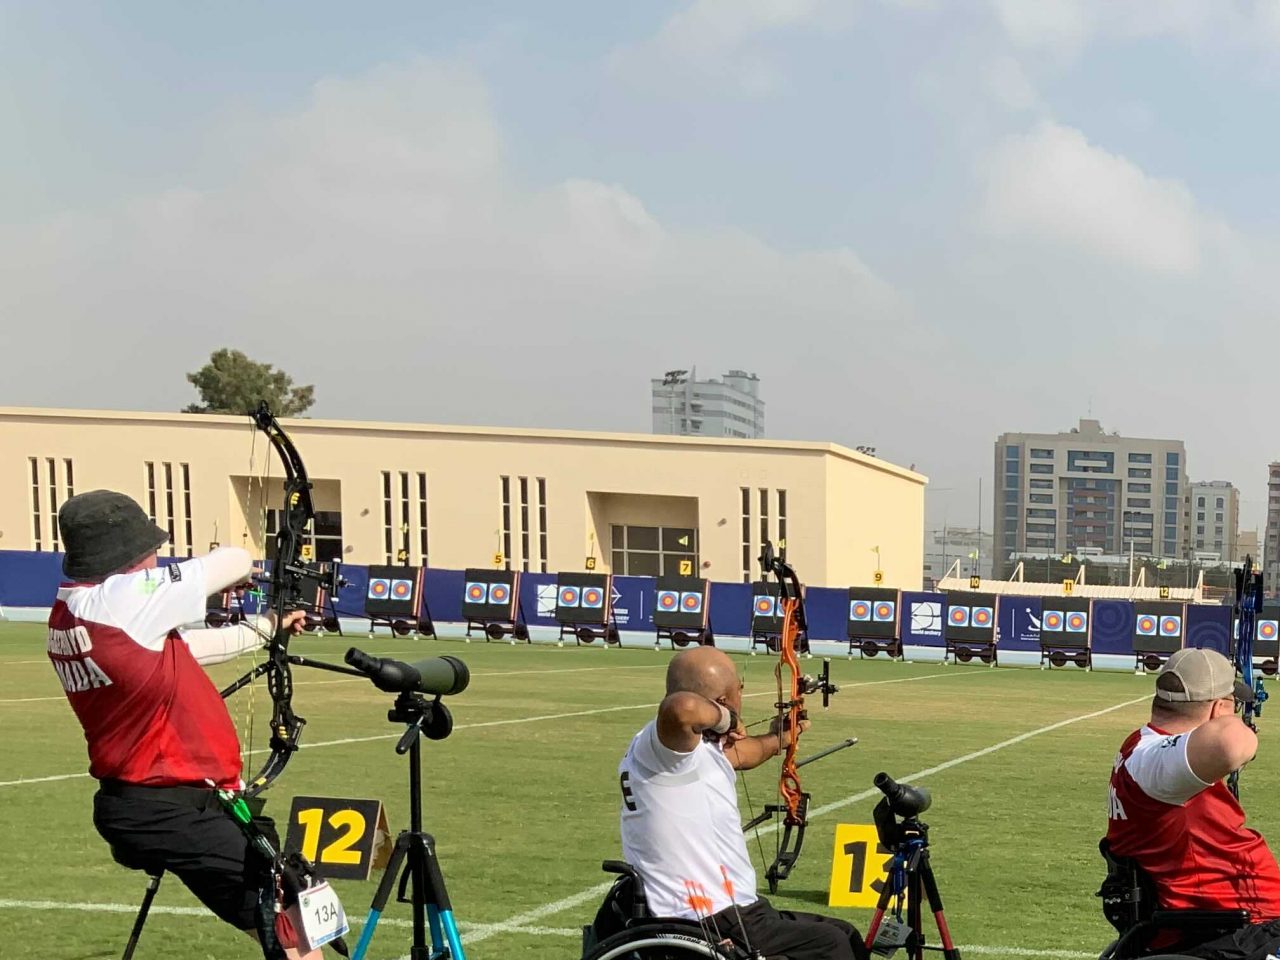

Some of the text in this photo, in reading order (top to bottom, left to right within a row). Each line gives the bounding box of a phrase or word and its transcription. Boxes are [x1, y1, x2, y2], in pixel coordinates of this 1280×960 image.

[304, 547, 311, 556] 3
[494, 555, 502, 563] 5
[682, 563, 690, 572] 7
[970, 577, 979, 586] 10
[1064, 582, 1072, 591] 11
[1160, 588, 1169, 597] 12
[297, 808, 366, 865] 12
[314, 901, 339, 925] 13A
